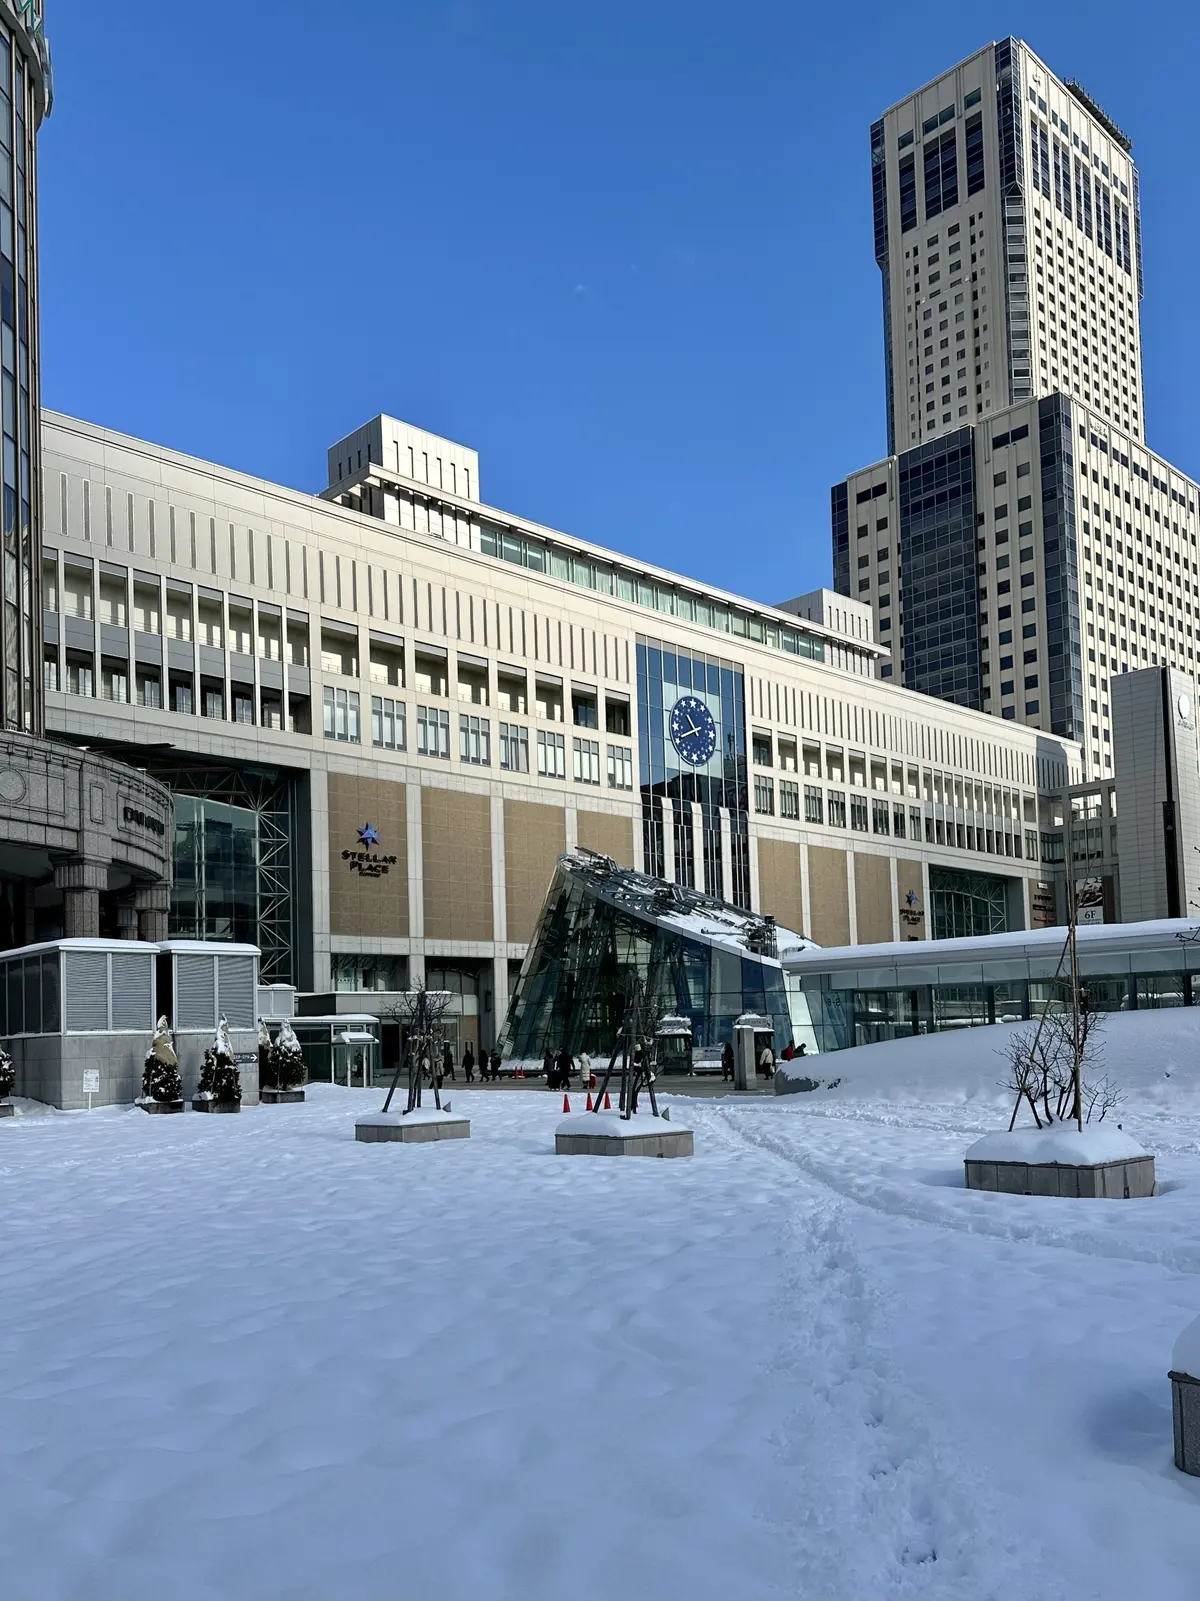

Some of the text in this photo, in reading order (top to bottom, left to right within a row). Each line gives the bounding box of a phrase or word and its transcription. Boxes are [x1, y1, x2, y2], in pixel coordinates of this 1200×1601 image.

[341, 849, 397, 865] STELLAR
[350, 860, 390, 874] PLACE
[1084, 910, 1097, 919] 6F
